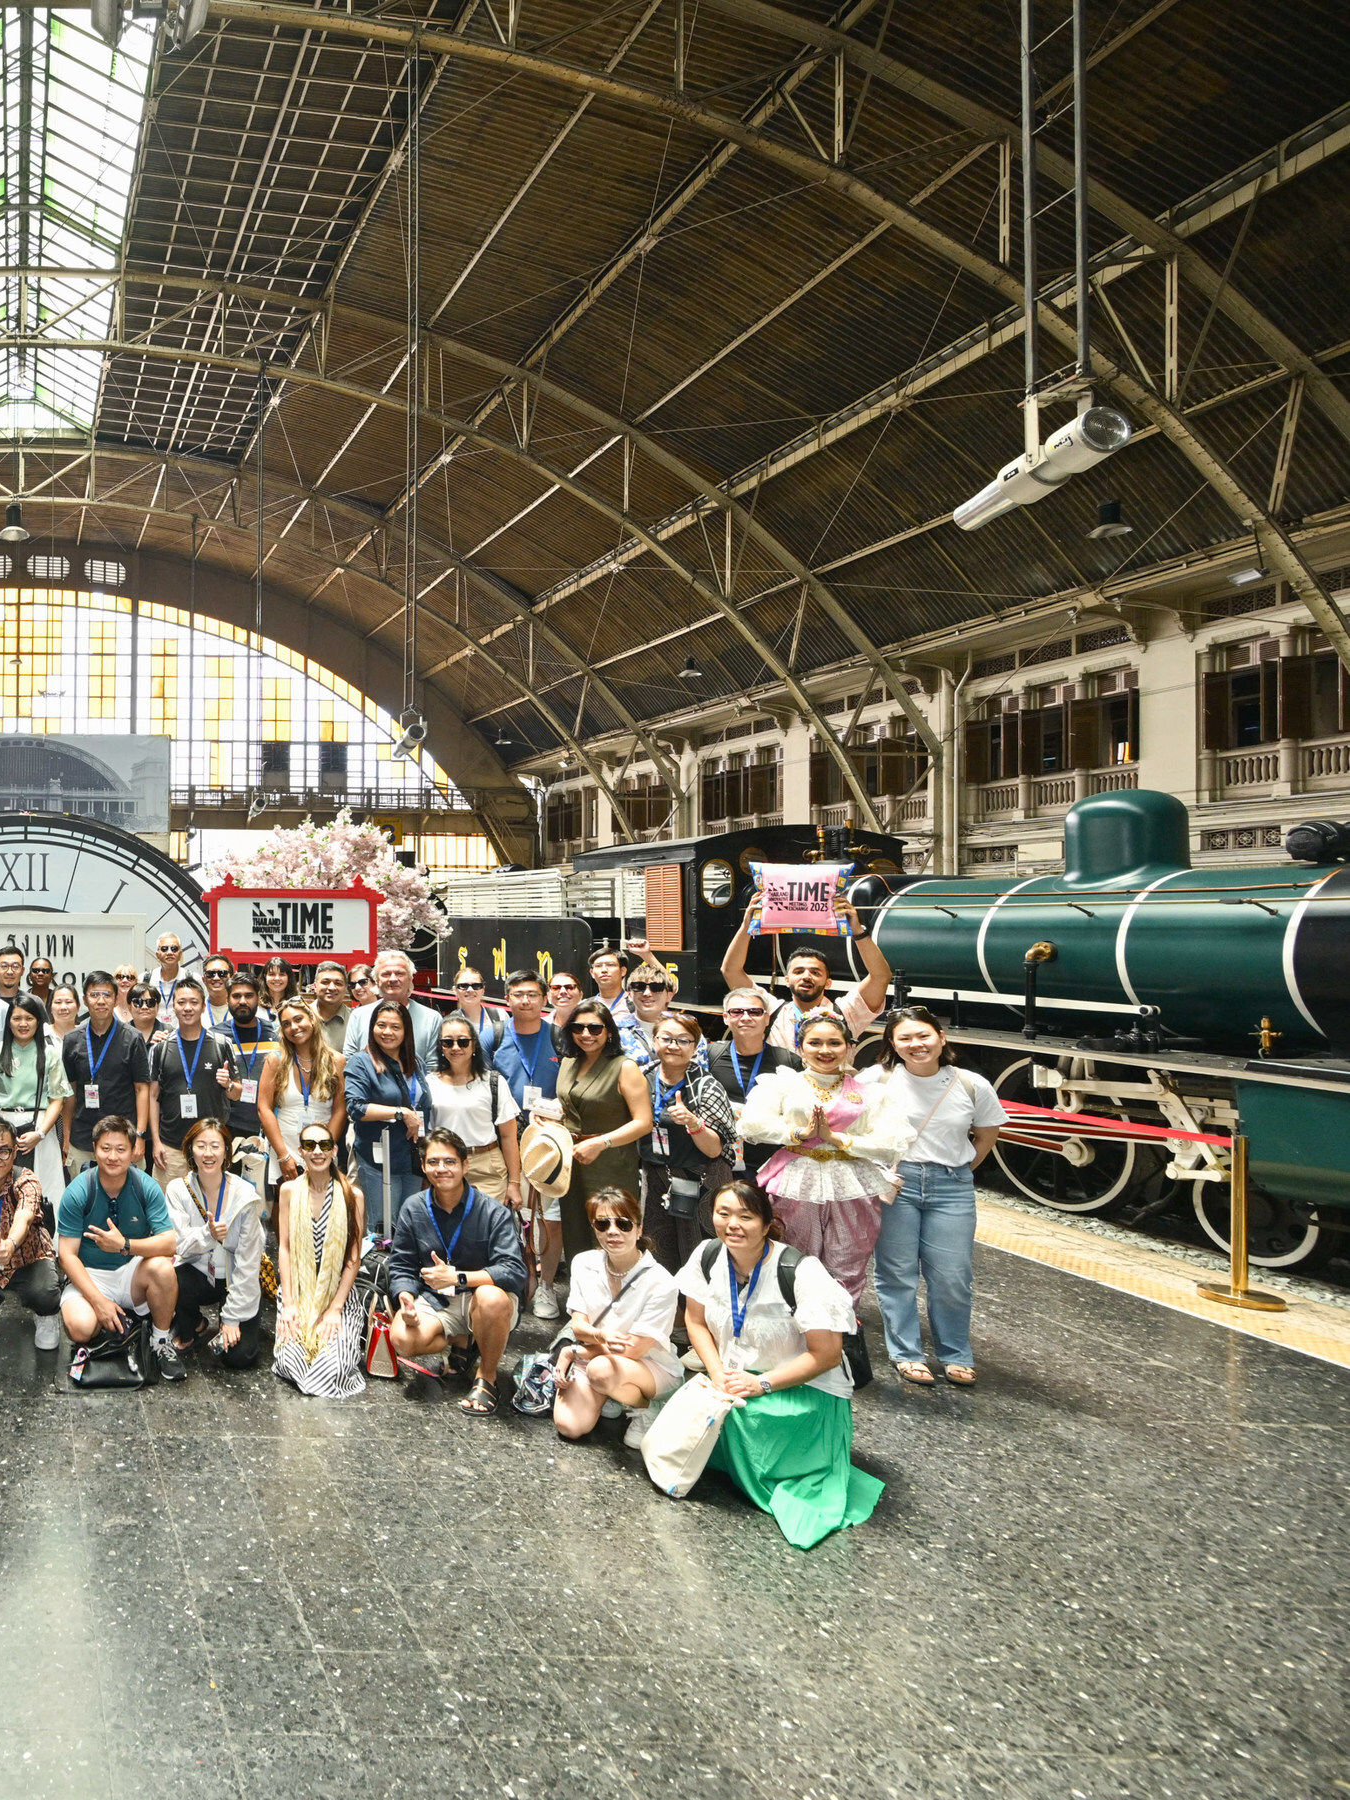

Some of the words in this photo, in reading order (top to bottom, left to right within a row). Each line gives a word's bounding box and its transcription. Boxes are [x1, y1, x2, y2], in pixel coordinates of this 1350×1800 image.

[787, 882, 830, 902] TIME
[810, 903, 828, 912] 2025
[252, 918, 280, 926] THAILAND
[278, 903, 333, 934] TIME
[281, 942, 307, 950] EXCHANGE
[308, 935, 334, 950] 2025
